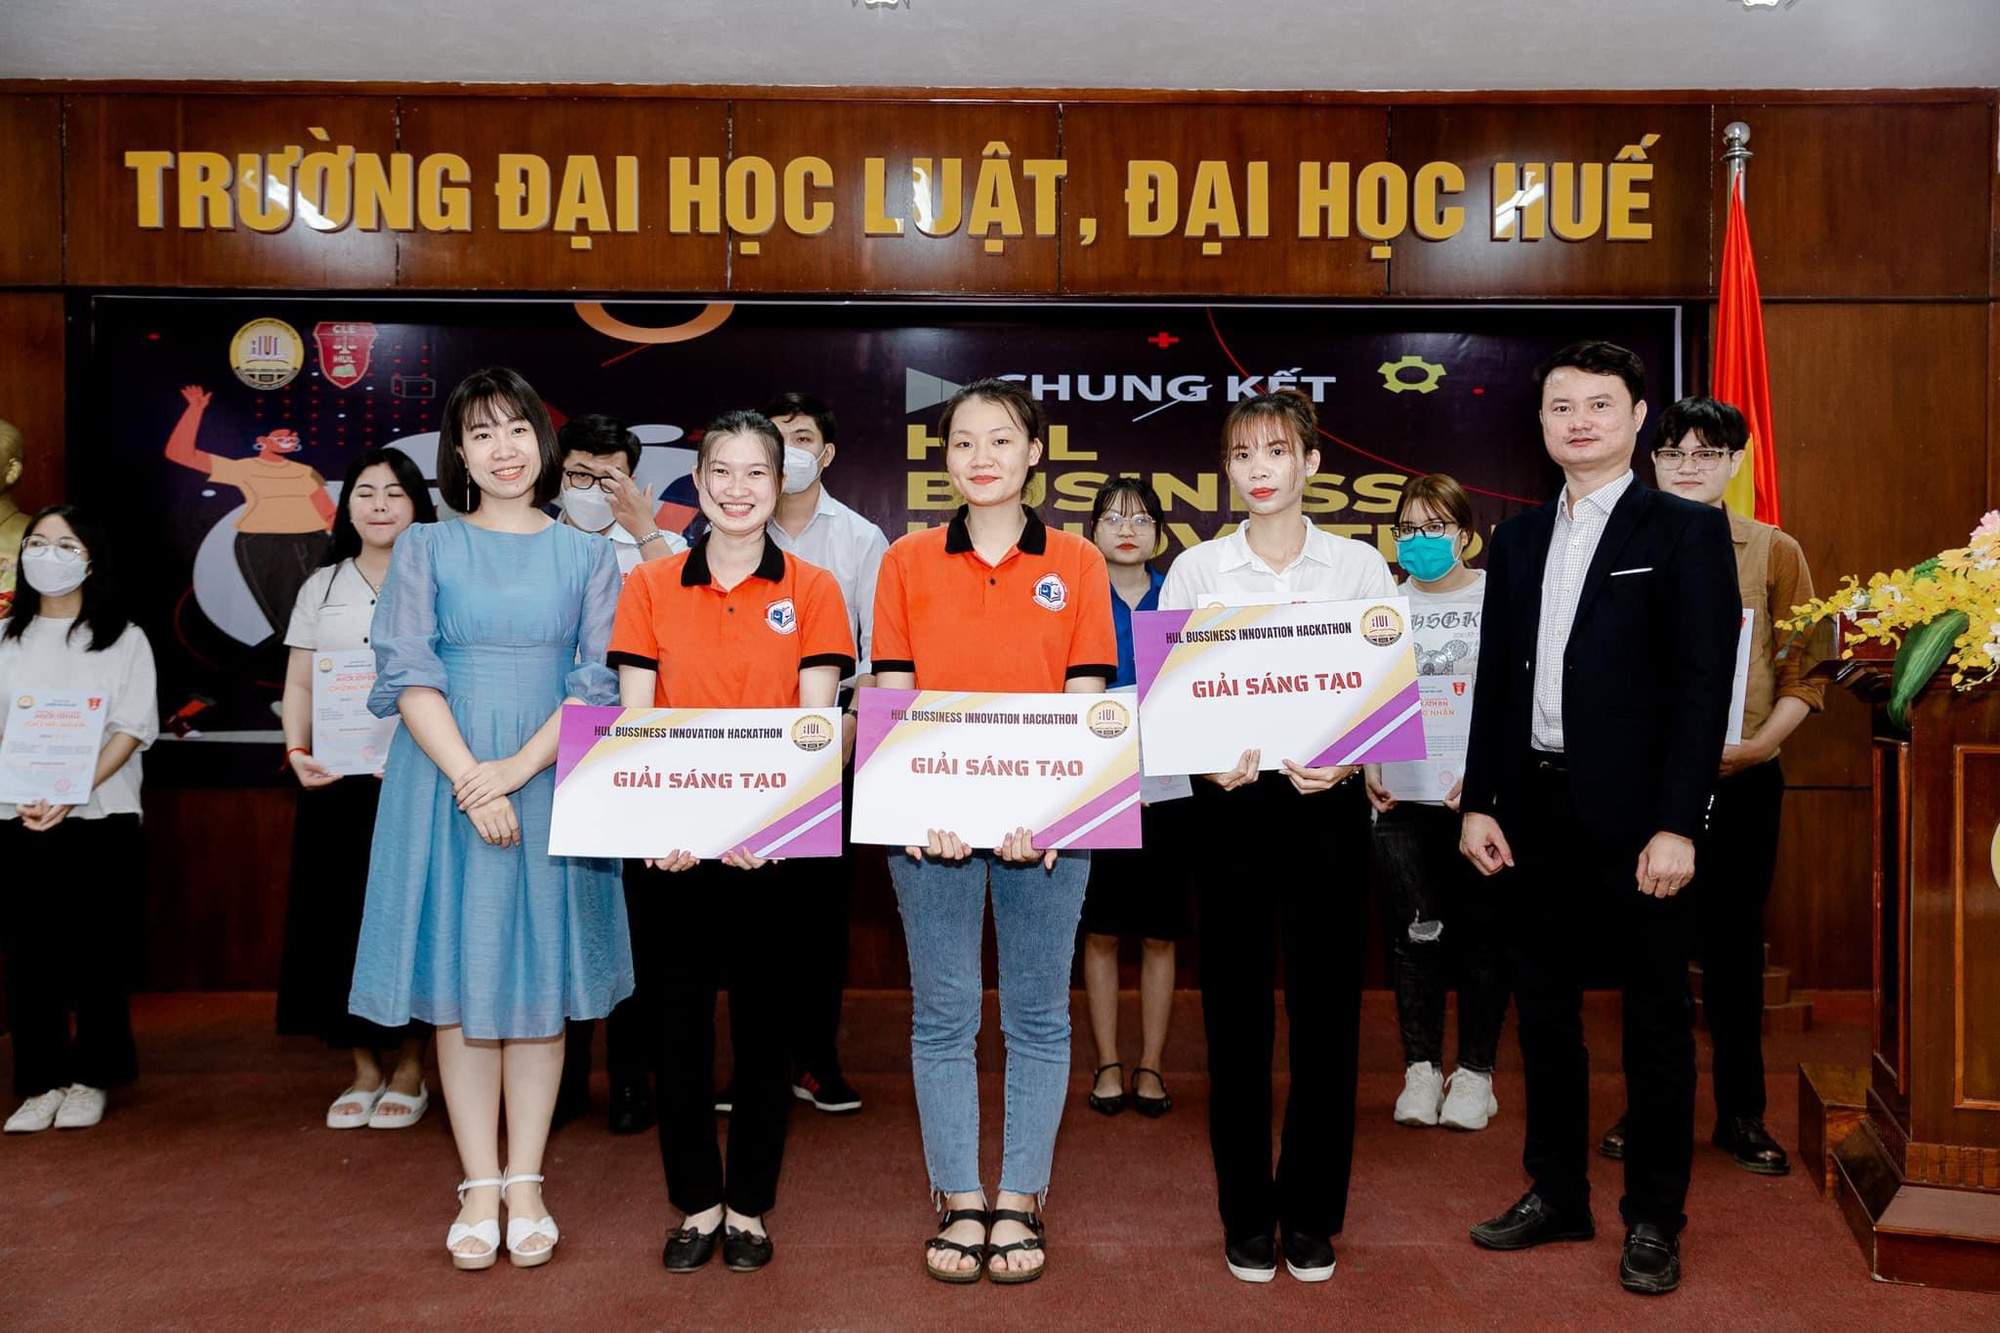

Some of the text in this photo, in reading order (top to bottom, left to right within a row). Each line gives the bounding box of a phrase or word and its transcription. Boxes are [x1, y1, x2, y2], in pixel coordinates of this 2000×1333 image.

[124, 127, 473, 233] TRƯỜNG
[494, 154, 640, 250] ĐẠI
[669, 155, 834, 255] HỌC
[1125, 160, 1270, 256] ĐẠI
[1298, 161, 1466, 260] HỌC
[1491, 133, 1661, 242] HUẾ
[999, 374, 1209, 402] HUNG
[907, 424, 1098, 461] HL
[1166, 622, 1352, 644] HUL BUSSINESS INNOVATION HACKATHON
[1192, 671, 1362, 699] GIẢI SÁNG TẠO
[891, 709, 1078, 725] HUL BUSSINESS INNOVATION HACKATHON
[594, 725, 783, 740] HUL BUSSINESS INNOVATION HACKATHON
[613, 765, 787, 793] GIẢI SÁNG TẠO
[911, 751, 1084, 781] GIẢI SÁNG TẠO
